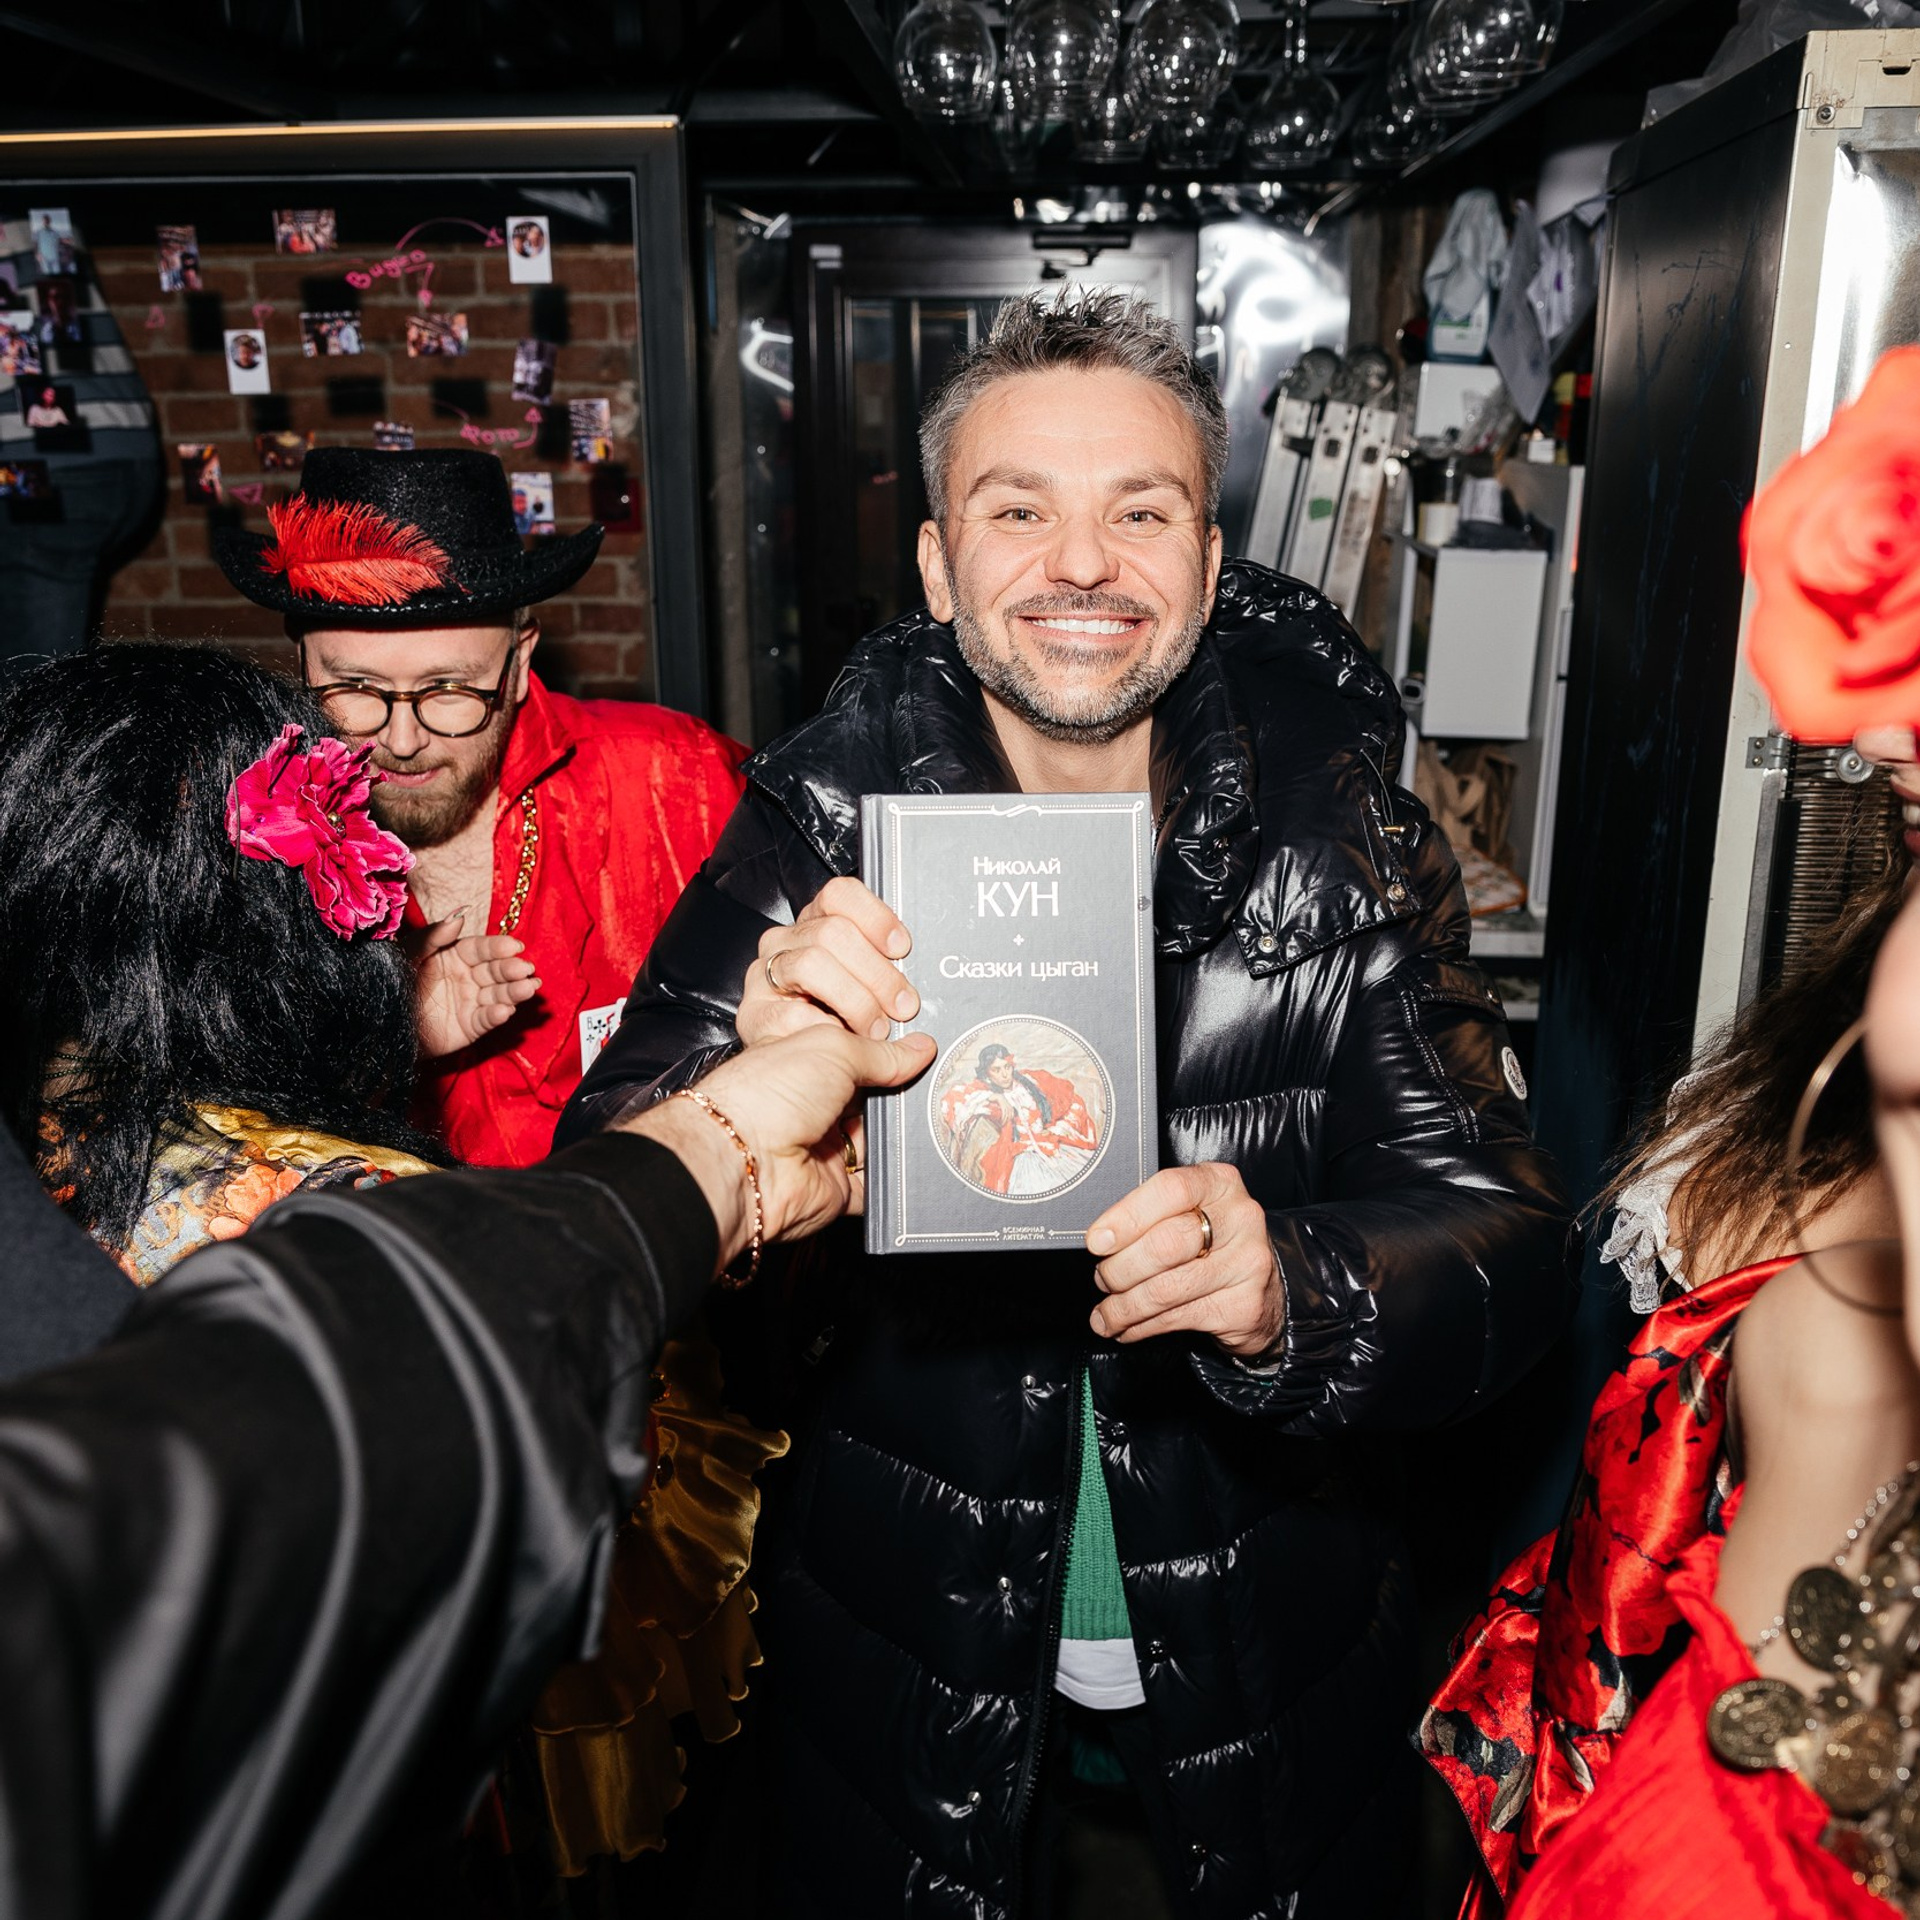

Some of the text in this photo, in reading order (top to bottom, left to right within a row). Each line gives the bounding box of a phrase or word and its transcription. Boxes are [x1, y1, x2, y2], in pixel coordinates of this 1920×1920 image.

[973, 856, 1061, 876] Николай
[977, 881, 1059, 917] КУН
[939, 955, 1098, 982] Сказки цыган
